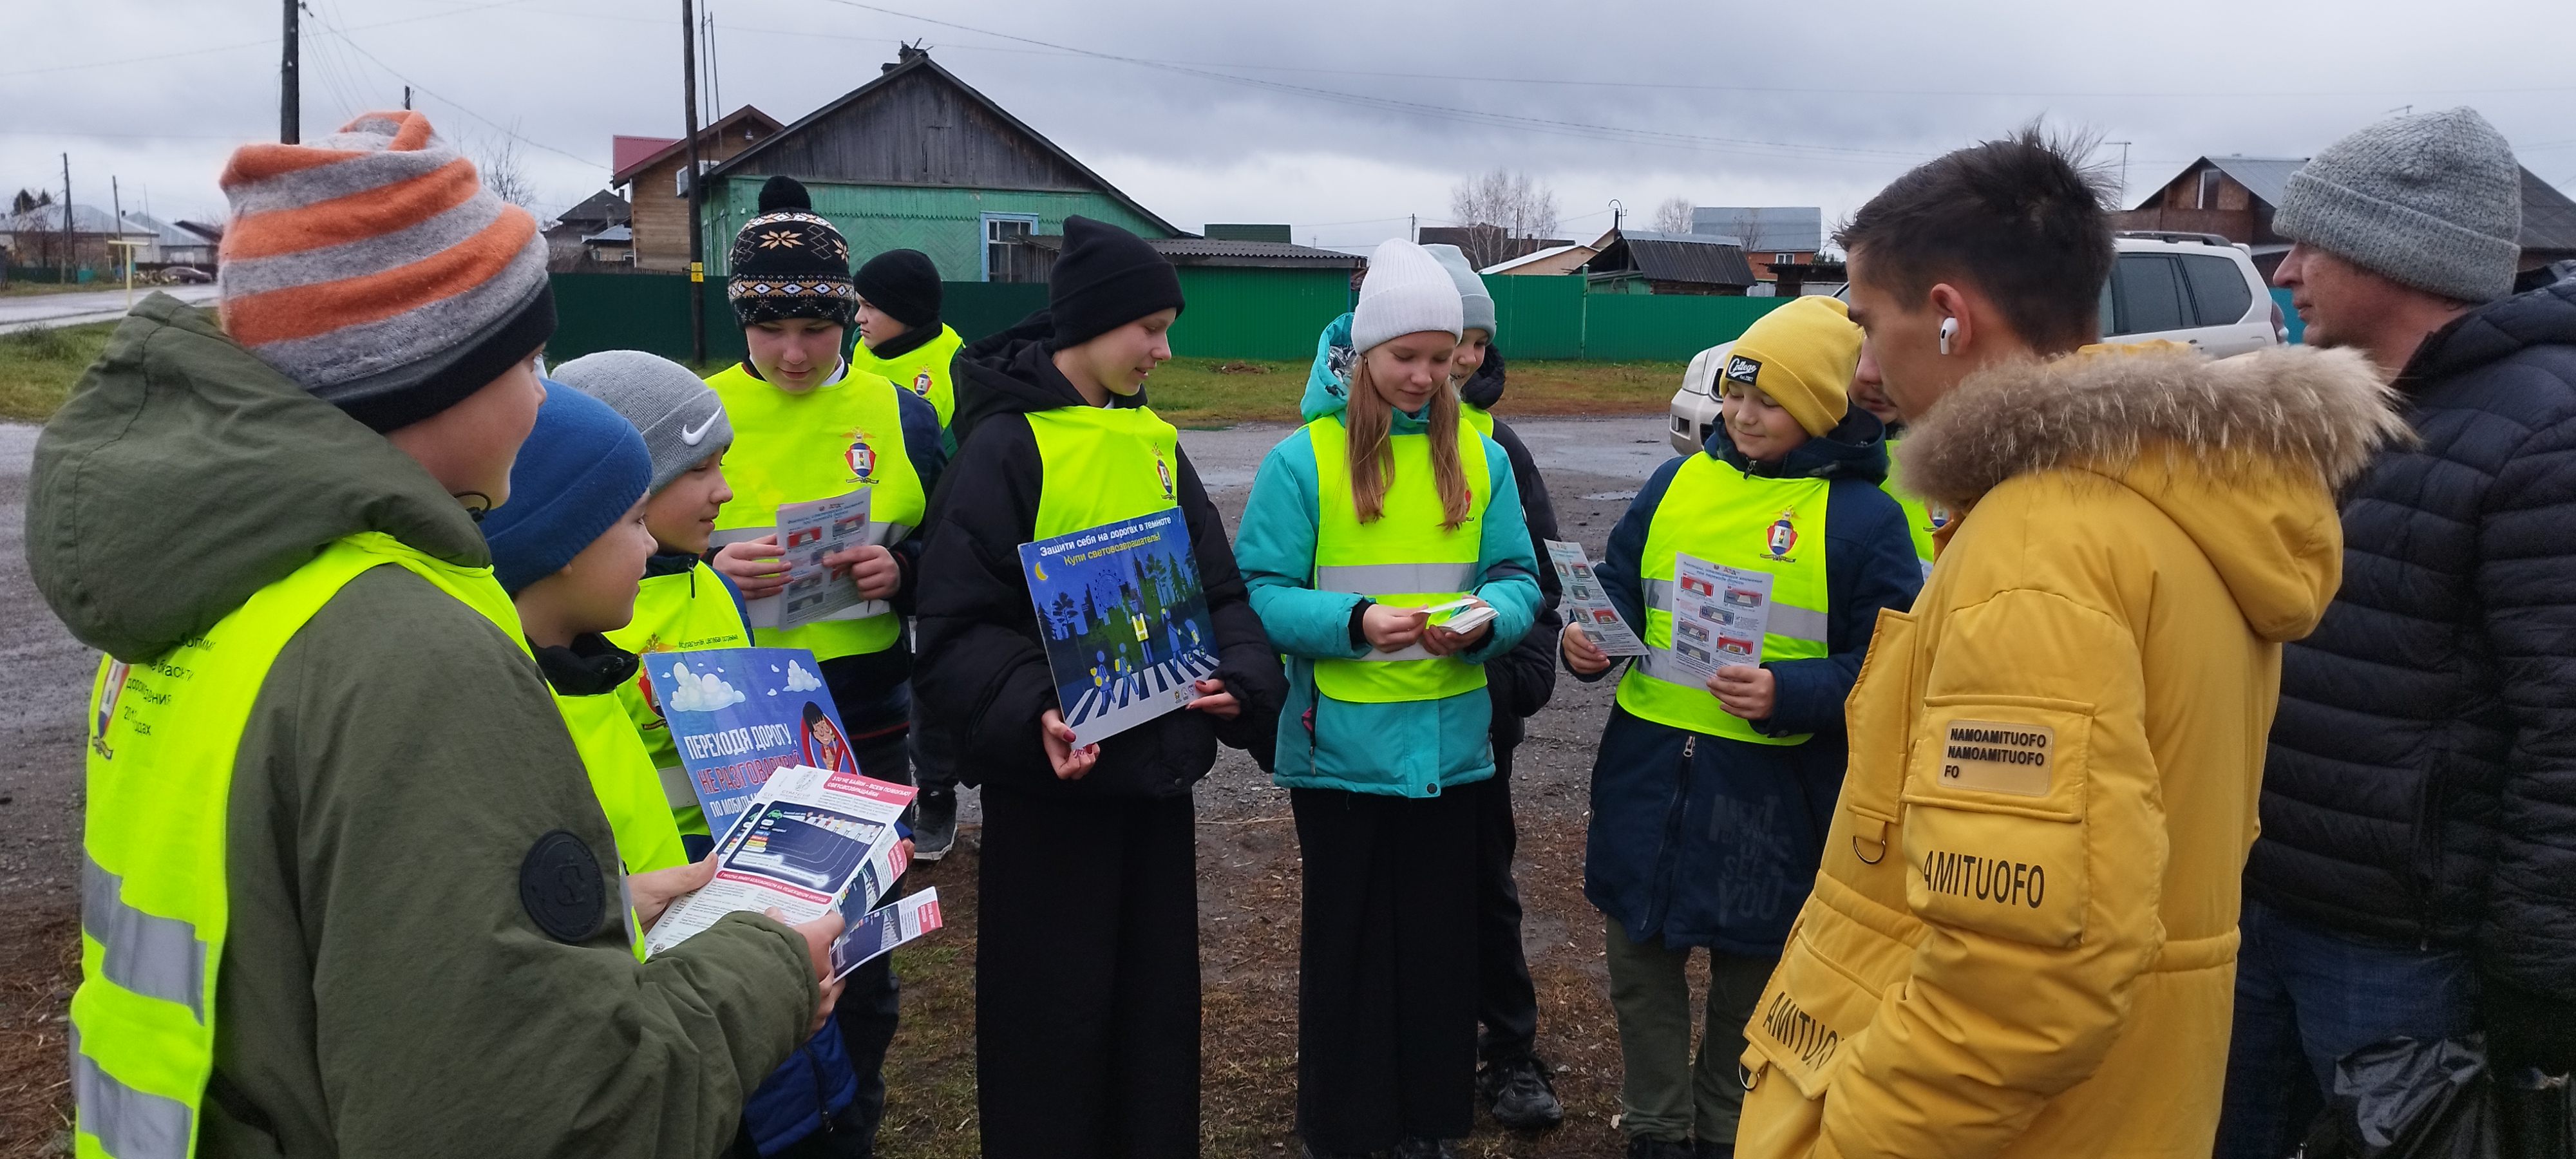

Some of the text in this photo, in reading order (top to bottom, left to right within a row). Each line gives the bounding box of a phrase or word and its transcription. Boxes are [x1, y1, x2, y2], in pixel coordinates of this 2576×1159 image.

[1728, 357, 1757, 377] College
[1039, 516, 1171, 557] Защити себя на дорогах в темноте
[1063, 552, 1086, 566] Купи
[683, 723, 798, 760] ПЕРЕХОДЯ ДОРОГУ,
[1950, 728, 2047, 748] NAMOAMITUOFO
[1947, 746, 2045, 766] NAMOAMITUOFO
[696, 768, 719, 795] НЕ
[1944, 765, 1959, 778] FO
[709, 800, 723, 818] ПО
[1924, 850, 2045, 909] AMITUOFO
[1763, 990, 1846, 1071] AMITUO
